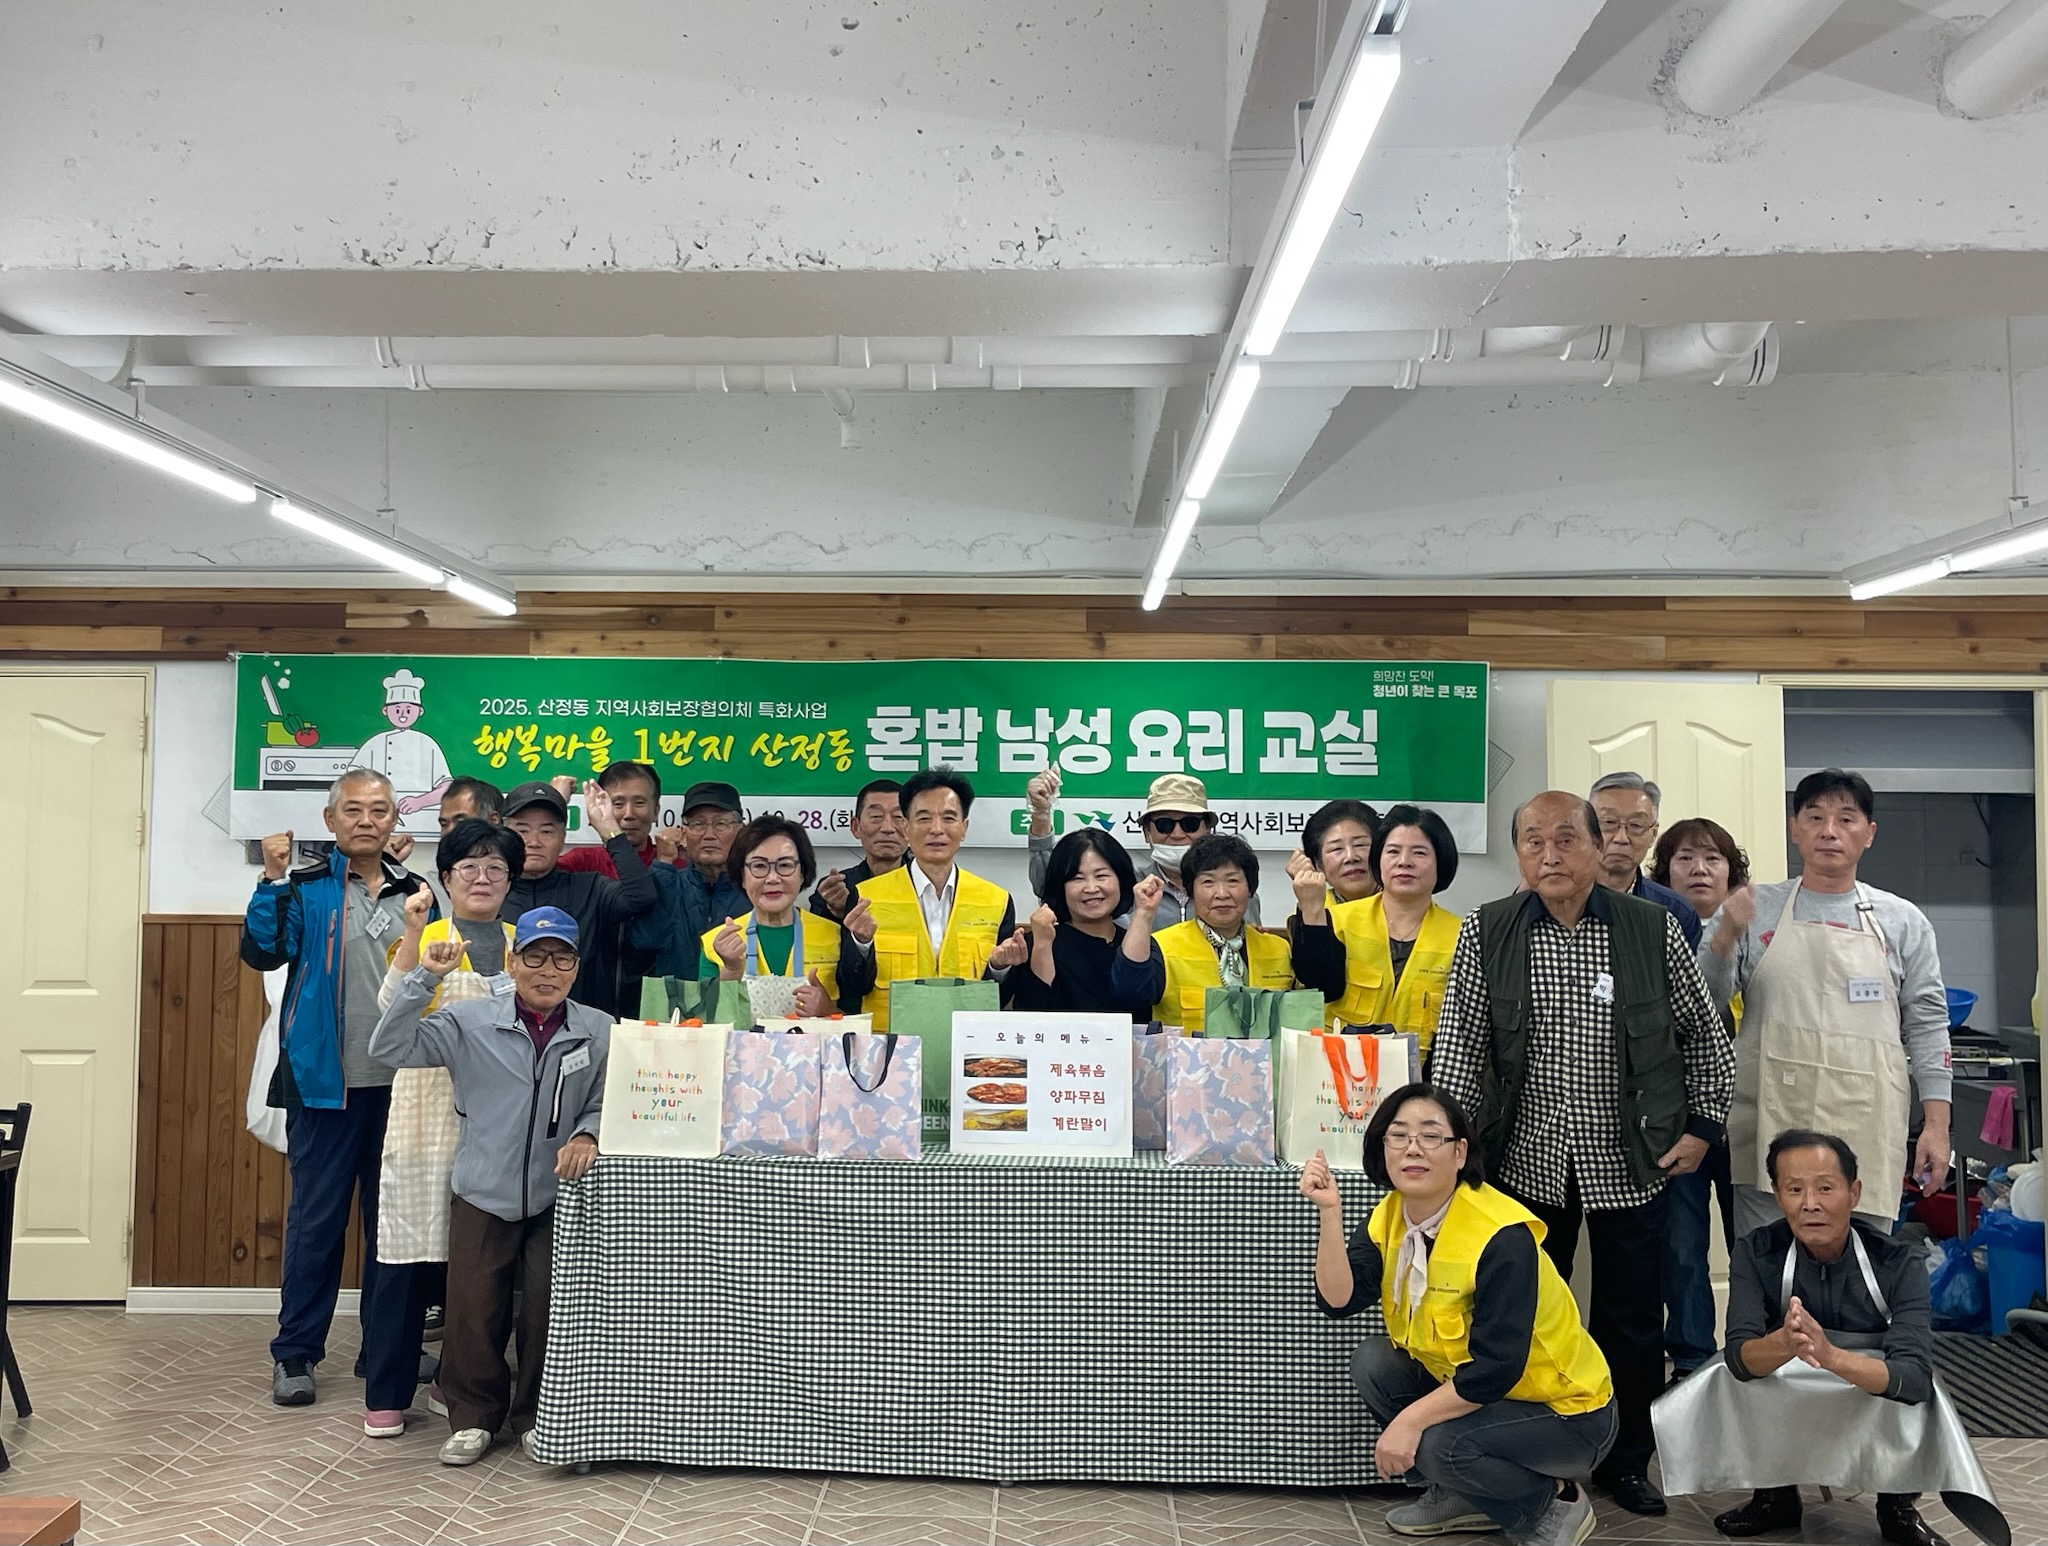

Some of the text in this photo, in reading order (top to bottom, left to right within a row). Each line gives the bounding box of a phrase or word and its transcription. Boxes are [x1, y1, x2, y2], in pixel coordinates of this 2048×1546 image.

[1373, 670, 1434, 682] 희망찬 도약!
[1373, 684, 1477, 699] 청년이 찾는 큰 목포
[479, 698, 827, 719] 2025. 산정동 지역사회보장협의체 특화사업
[473, 723, 855, 773] 행복마을 1번지 산정동
[865, 706, 1379, 776] 혼밥 남성 요리 교실
[637, 1068, 698, 1082] think happy
[1050, 1063, 1106, 1078] 제육볶음
[630, 1082, 703, 1095] thoughts with
[652, 1098, 683, 1110] your
[1050, 1090, 1106, 1105] 양파무침
[922, 1098, 949, 1113] INK
[632, 1110, 697, 1122] beautiful life
[1052, 1116, 1107, 1131] 계란말이
